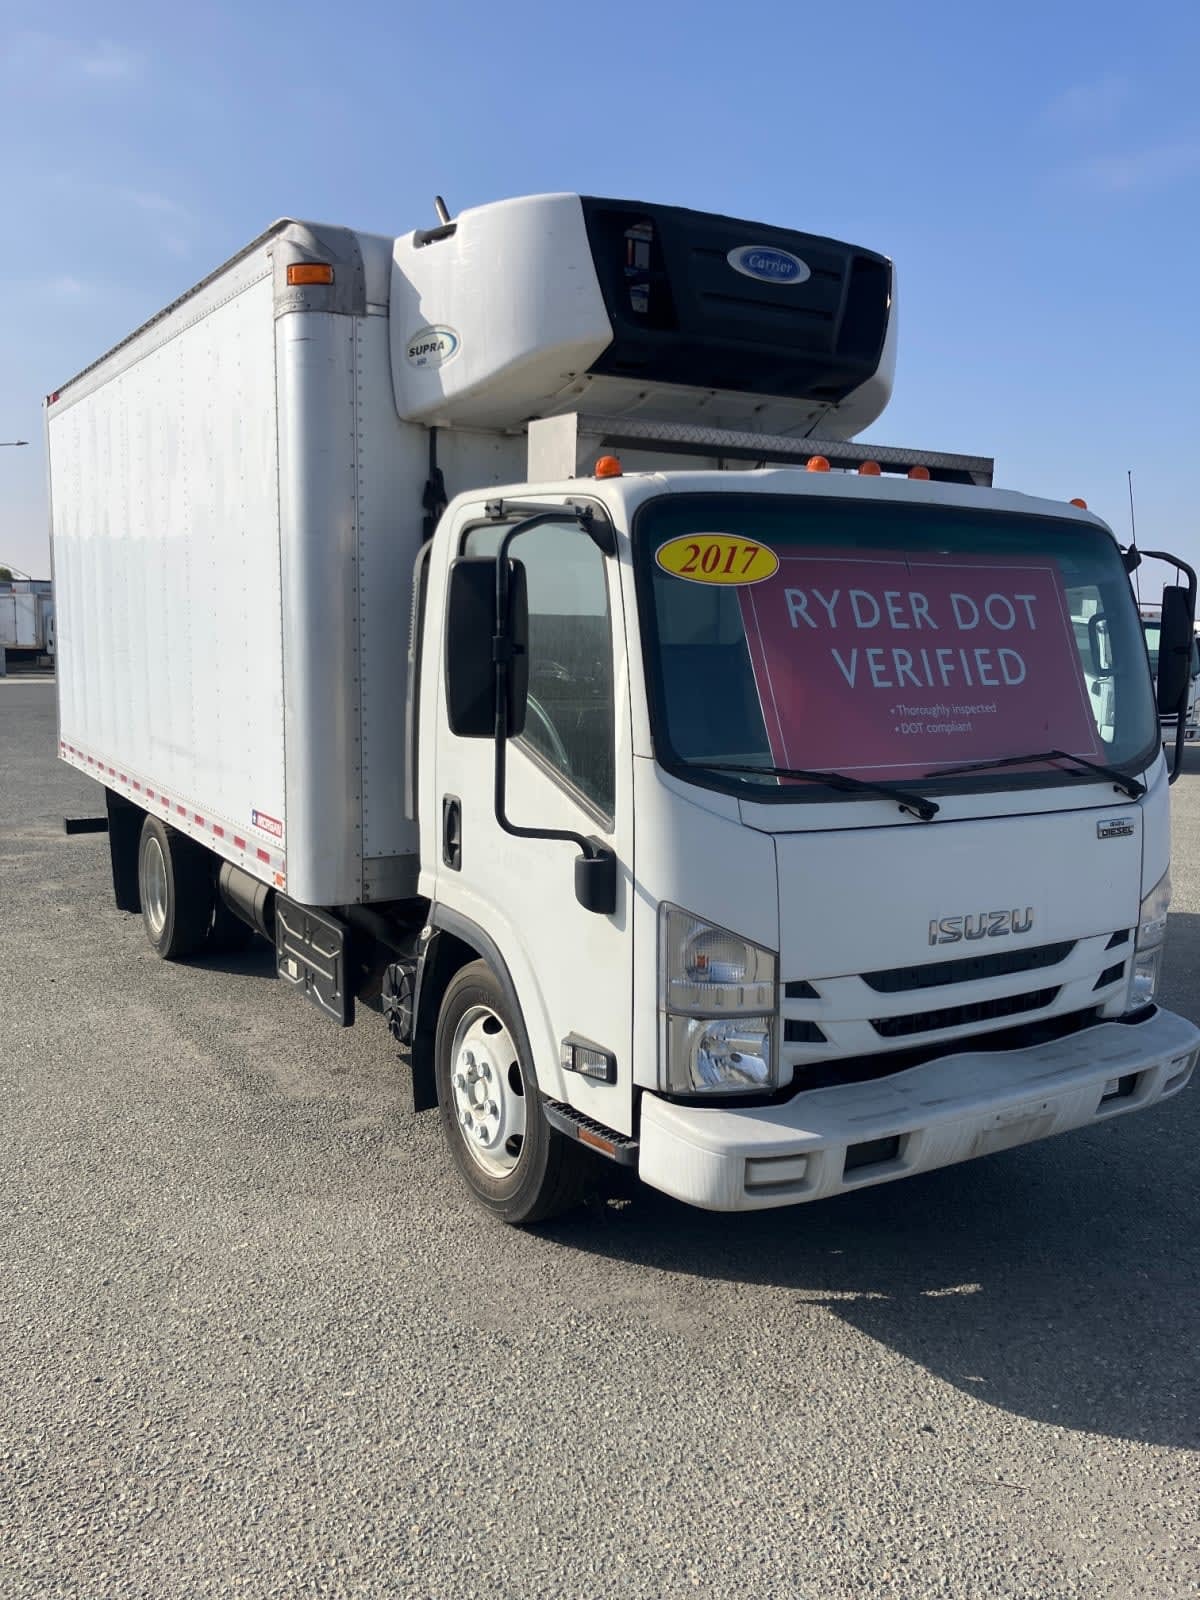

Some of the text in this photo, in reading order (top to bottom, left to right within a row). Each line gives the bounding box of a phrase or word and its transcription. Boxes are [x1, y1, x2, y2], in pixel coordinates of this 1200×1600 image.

[749, 255, 793, 273] Carrier
[409, 341, 444, 357] SUPRA
[679, 544, 759, 574] 2017
[784, 588, 1037, 631] RYDER DOT
[831, 648, 1027, 689] VERIFIED
[896, 703, 997, 718] Thoroughly inspected
[901, 721, 972, 736] DOT compliant
[1101, 825, 1134, 837] DIESEL
[928, 906, 1033, 946] ISUZU
